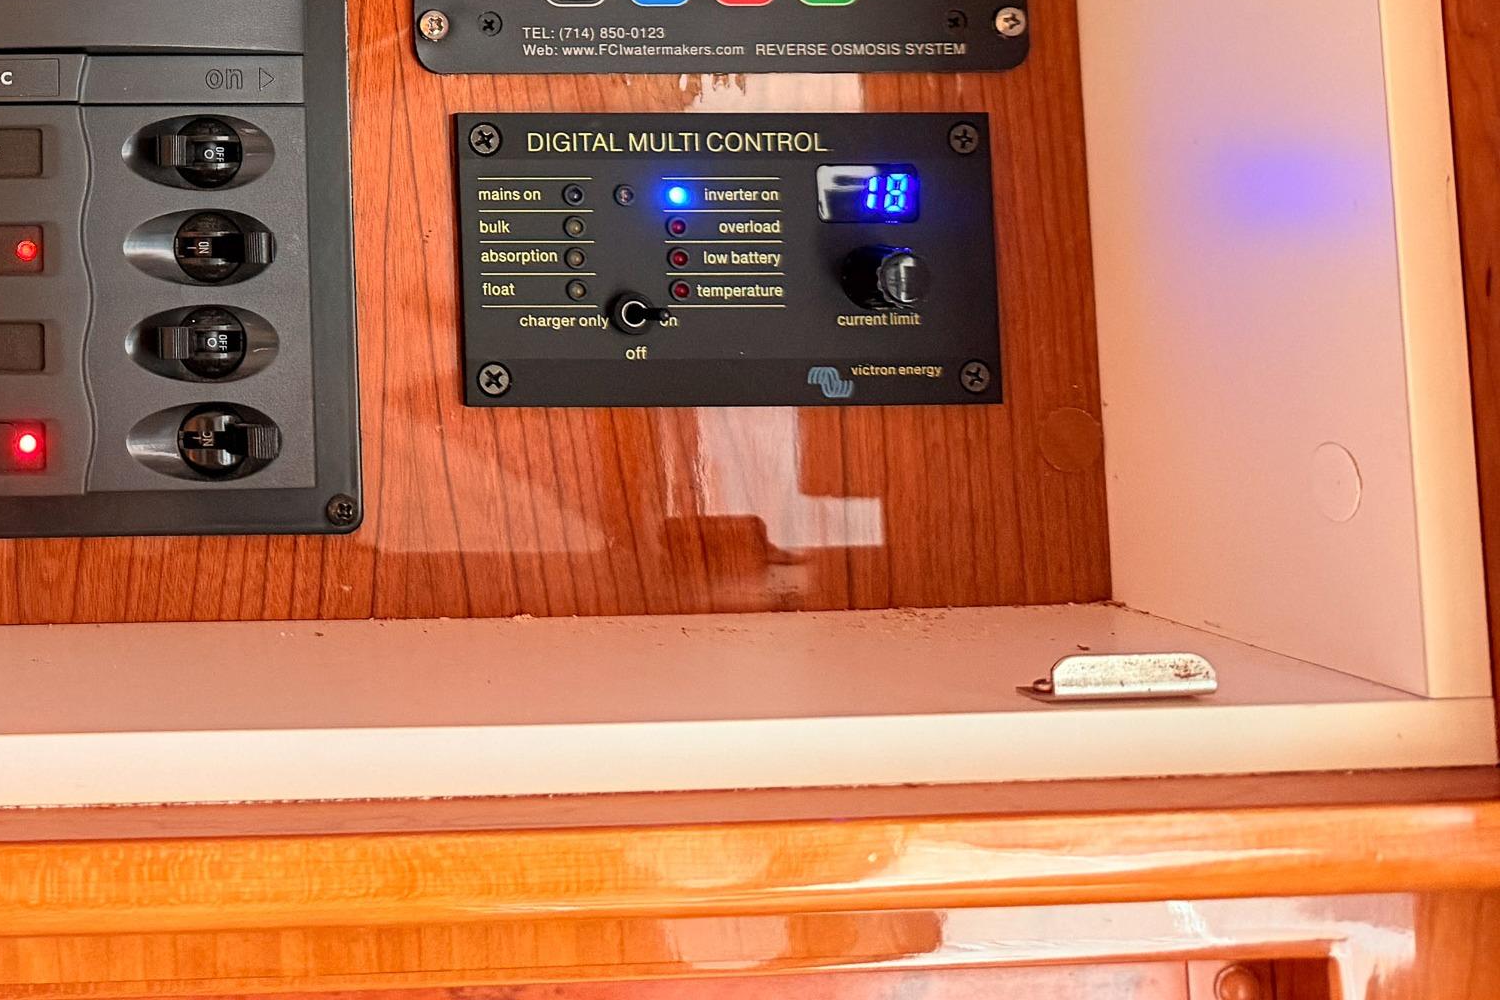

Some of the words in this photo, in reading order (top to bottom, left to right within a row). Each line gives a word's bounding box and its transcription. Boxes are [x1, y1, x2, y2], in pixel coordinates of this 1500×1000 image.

[523, 27, 554, 39] TEL:
[559, 27, 595, 41] (714)
[600, 27, 665, 39] 850-0123
[523, 44, 558, 56] Web:
[562, 43, 744, 56] www.FCIwatermakers.com
[755, 44, 826, 56] REVERSE
[831, 43, 900, 56] OSMOSIS
[905, 43, 966, 56] SYSTEM
[205, 67, 243, 91] on
[527, 132, 623, 152] DIGITAL
[628, 132, 699, 152] MULTI
[706, 132, 829, 152] CONTROL
[215, 146, 225, 162] OFF
[478, 188, 520, 201] mains
[523, 190, 541, 201] on
[704, 188, 758, 201] inverter
[762, 191, 779, 201] on
[866, 173, 908, 212] 18
[479, 220, 510, 233] bulk
[719, 220, 781, 233] overload
[481, 249, 558, 265] absorption
[703, 252, 727, 264] low
[731, 252, 781, 267] battery
[482, 283, 515, 296] float
[697, 285, 783, 298] temperature
[519, 315, 576, 329] charger
[579, 315, 609, 329] only
[837, 313, 886, 325] current
[890, 312, 920, 325] limit
[219, 335, 228, 351] OFF
[625, 347, 647, 359] off
[851, 365, 896, 376] victron
[898, 366, 943, 378] energy
